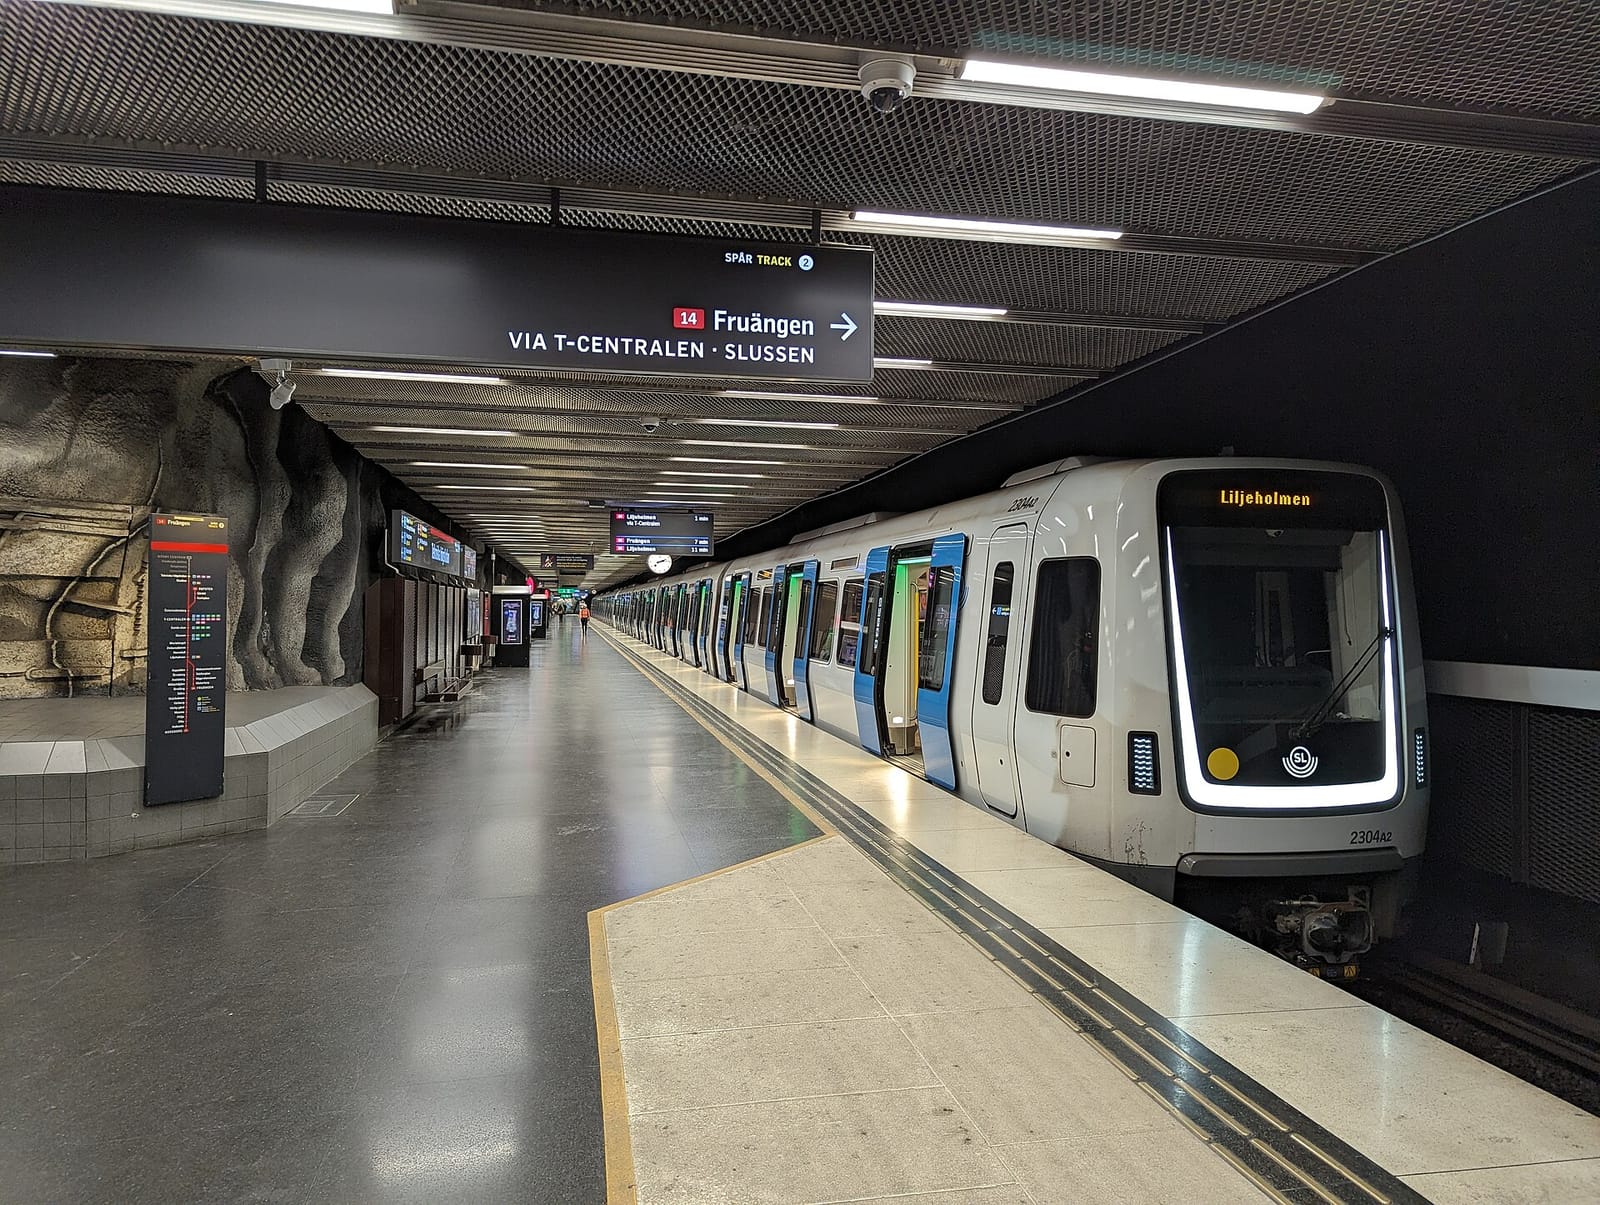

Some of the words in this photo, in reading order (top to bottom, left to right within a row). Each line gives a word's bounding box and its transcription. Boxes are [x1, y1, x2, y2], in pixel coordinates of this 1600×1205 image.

[724, 251, 753, 264] SPÅR
[757, 254, 792, 267] TRACK
[680, 312, 698, 325] 14
[714, 310, 814, 338] Fruängen
[508, 332, 547, 351] VIA
[554, 335, 704, 358] T-CENTRALEN
[724, 344, 814, 364] SLUSSEN
[1221, 489, 1310, 507] Liljeholmen
[1350, 829, 1393, 845] 2304A2
